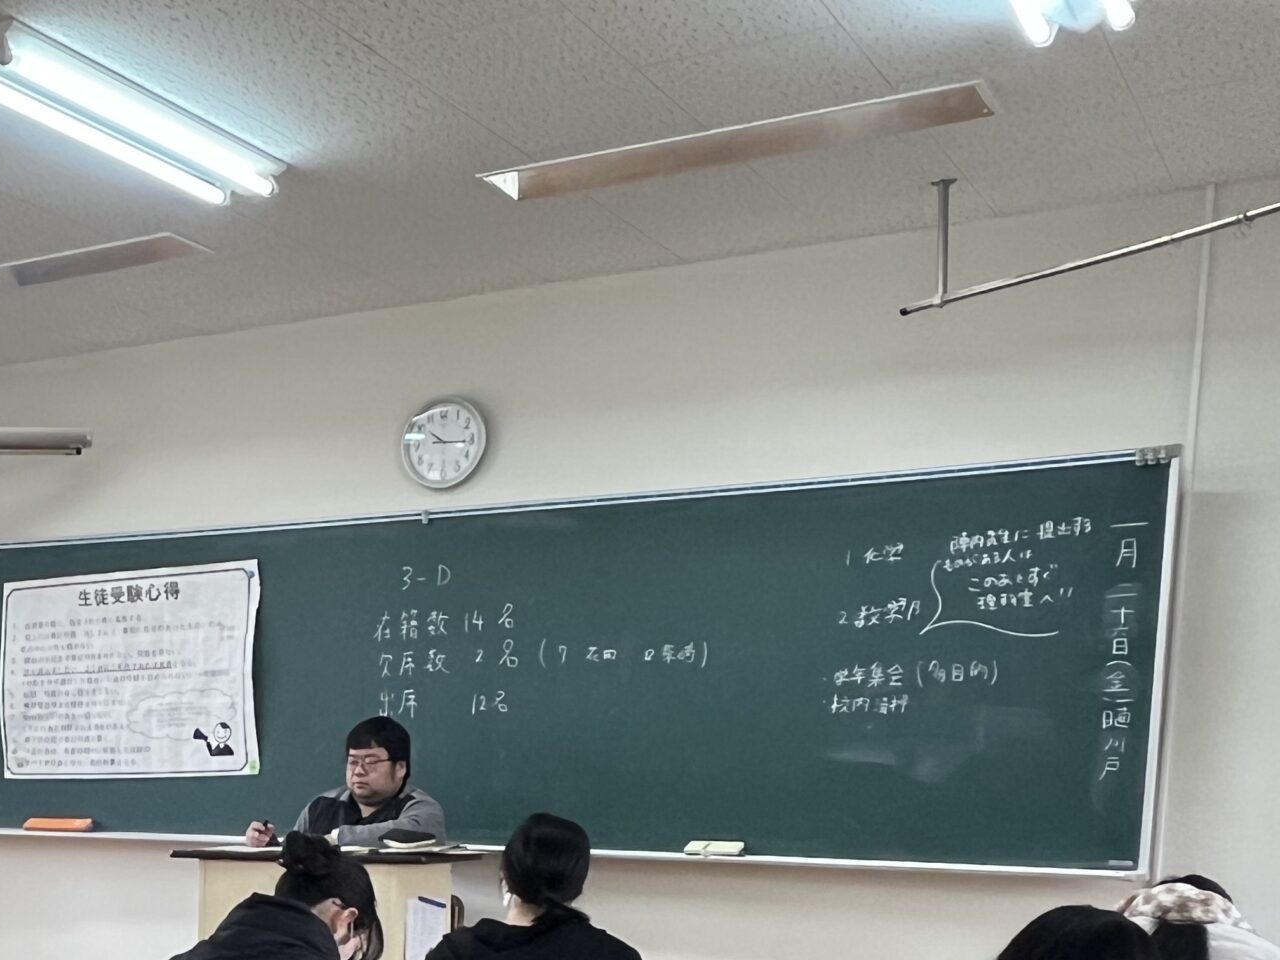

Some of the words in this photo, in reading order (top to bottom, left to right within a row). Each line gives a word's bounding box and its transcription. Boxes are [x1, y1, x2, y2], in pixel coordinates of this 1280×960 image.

[463, 416, 471, 430] 2
[78, 581, 180, 606] 生徒受験心得
